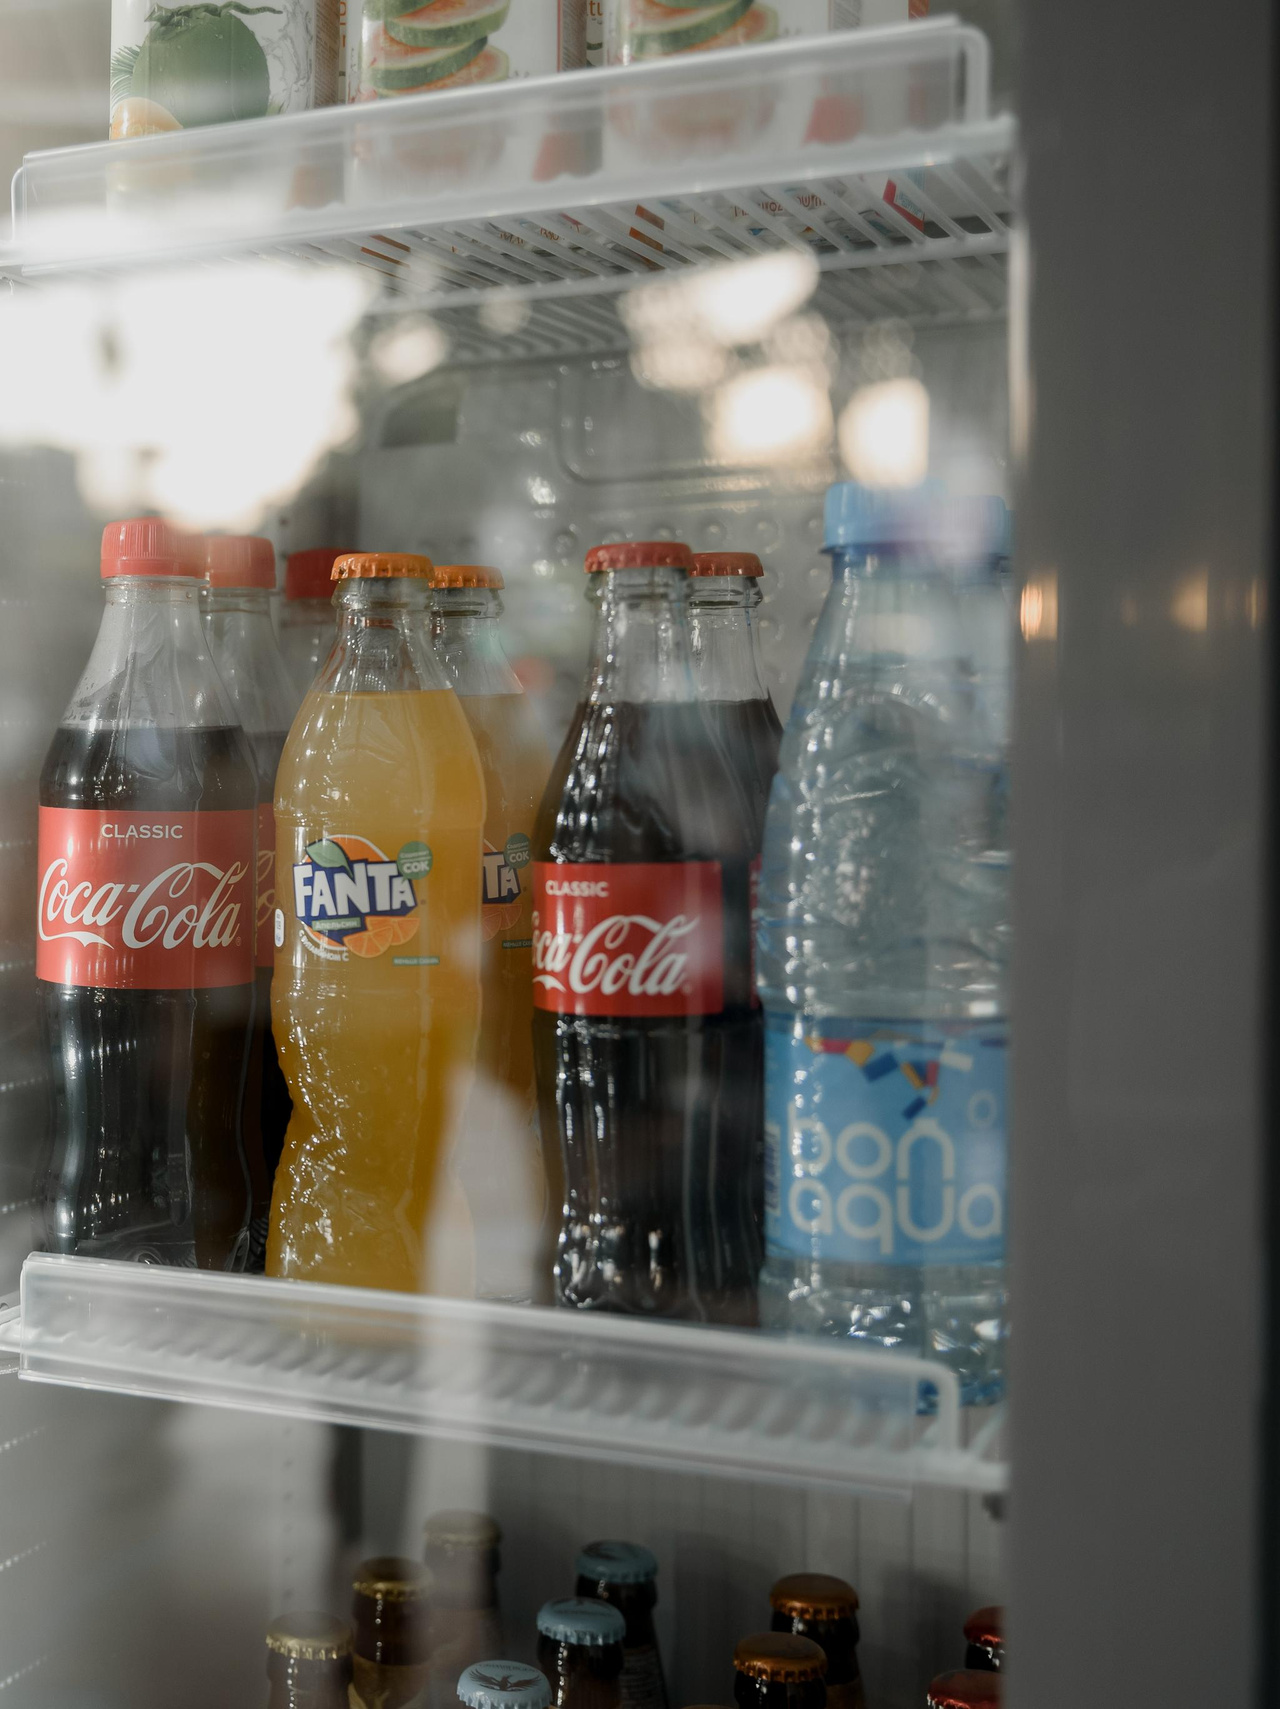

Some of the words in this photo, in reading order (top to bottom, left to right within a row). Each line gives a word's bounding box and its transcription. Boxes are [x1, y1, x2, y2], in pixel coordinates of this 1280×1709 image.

[101, 824, 183, 839] CLASSIC
[509, 850, 530, 863] СОК
[38, 858, 250, 949] Coca-Cola
[294, 862, 416, 917] FANTA
[545, 880, 609, 897] CLASSIC
[532, 911, 700, 996] ca-Cola
[788, 1178, 1003, 1255] aqua
